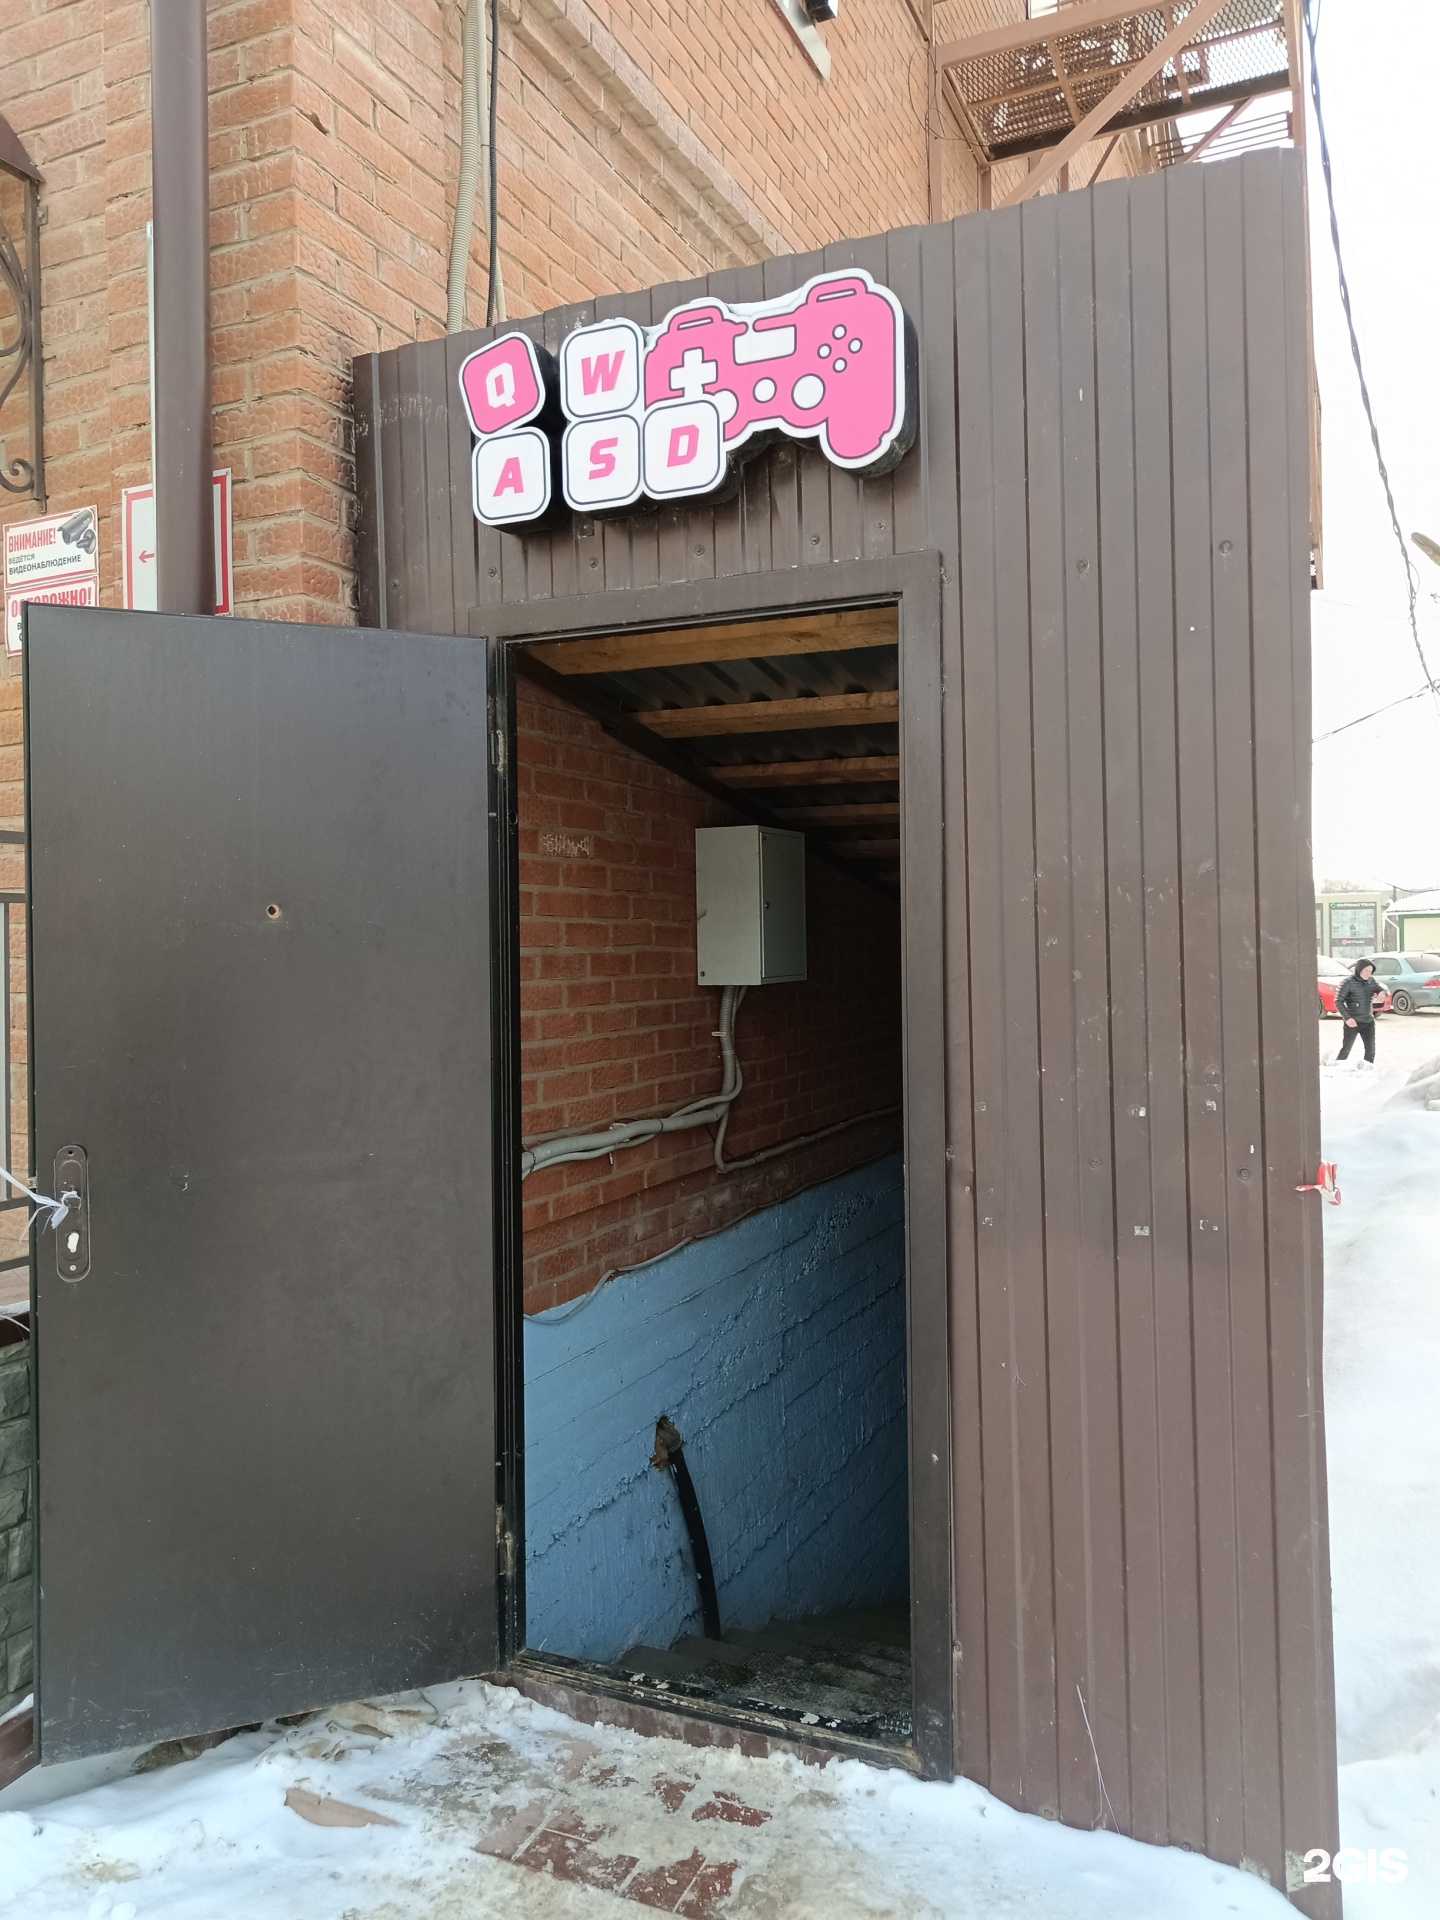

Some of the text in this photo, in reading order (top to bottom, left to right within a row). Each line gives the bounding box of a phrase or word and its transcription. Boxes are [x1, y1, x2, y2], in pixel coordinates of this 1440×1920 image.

[486, 350, 625, 408] Q W
[493, 424, 700, 497] A S D
[8, 527, 56, 552] ВНИМАНИЕ!
[9, 554, 82, 575] ВИДЕОНАБЛЮДЕНИЕ
